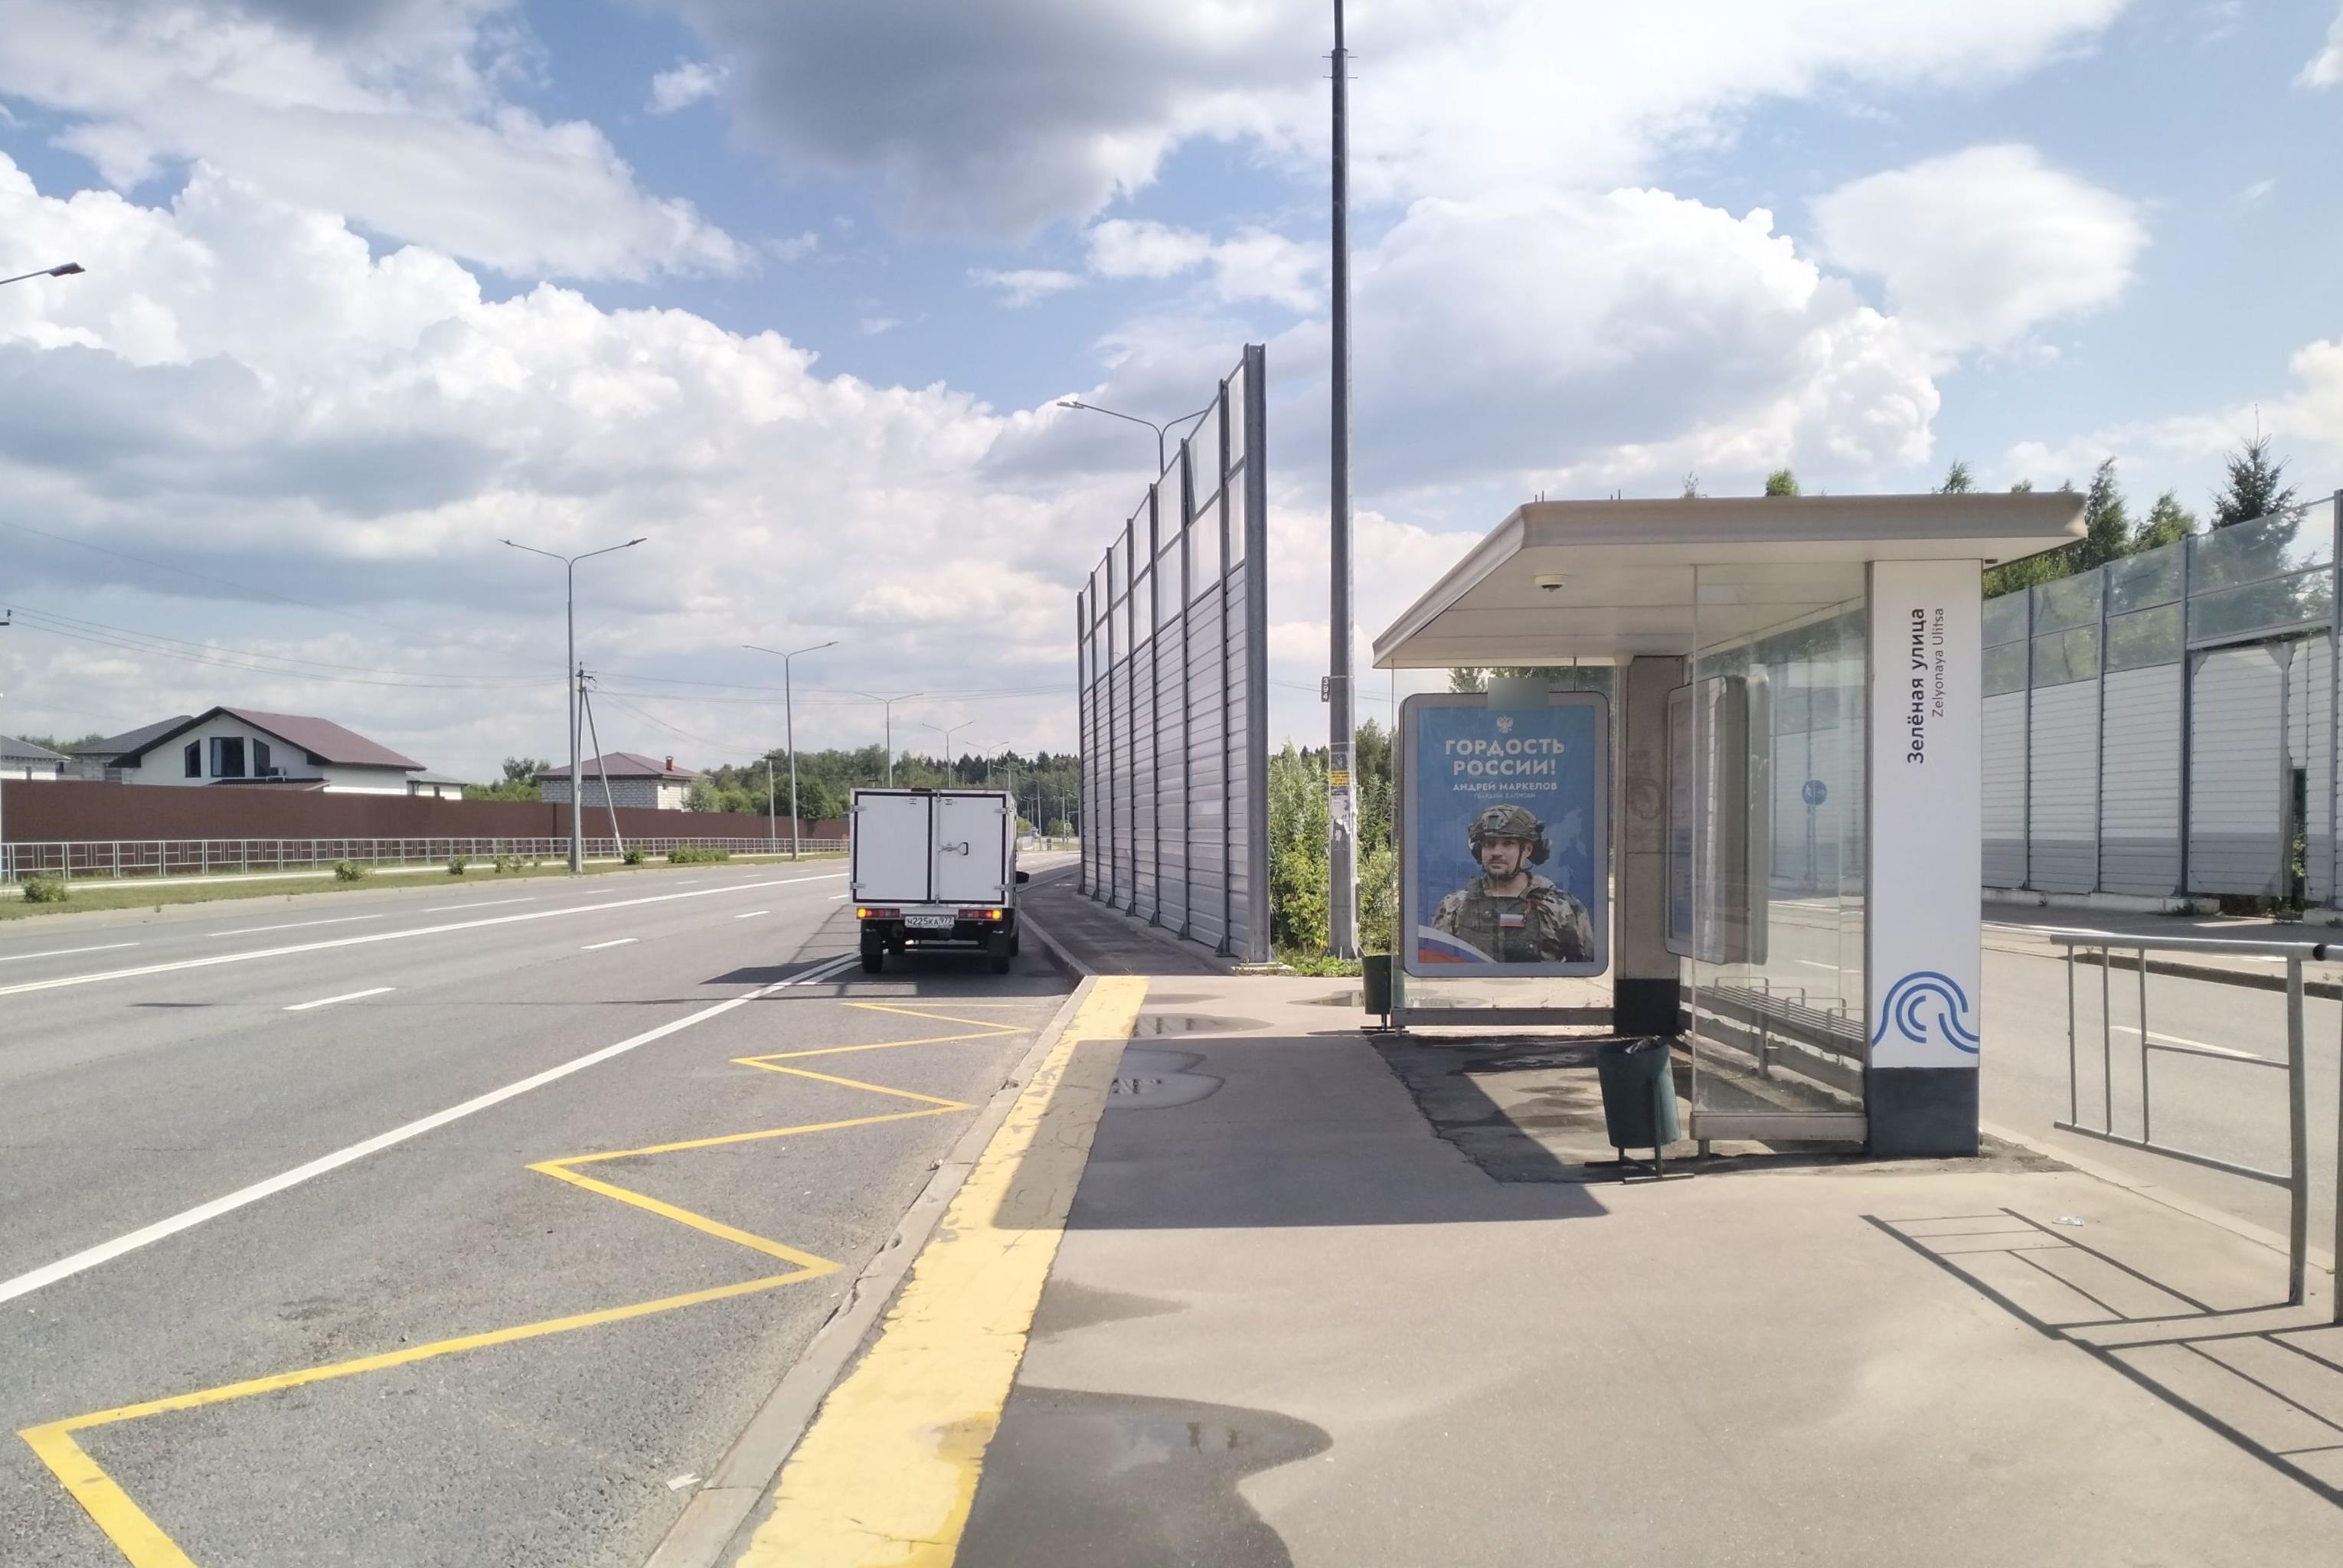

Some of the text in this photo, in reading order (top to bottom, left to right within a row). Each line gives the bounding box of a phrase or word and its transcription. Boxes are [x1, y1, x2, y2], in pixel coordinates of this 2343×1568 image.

[1932, 609, 1946, 717] Zelyonaya Ulitsa
[1907, 609, 1928, 763] Зелёная улица
[1446, 739, 1564, 756] ГОРДОСТЬ
[1453, 760, 1556, 776] РОССИИ!
[1453, 782, 1495, 791] АНДРЕЙ
